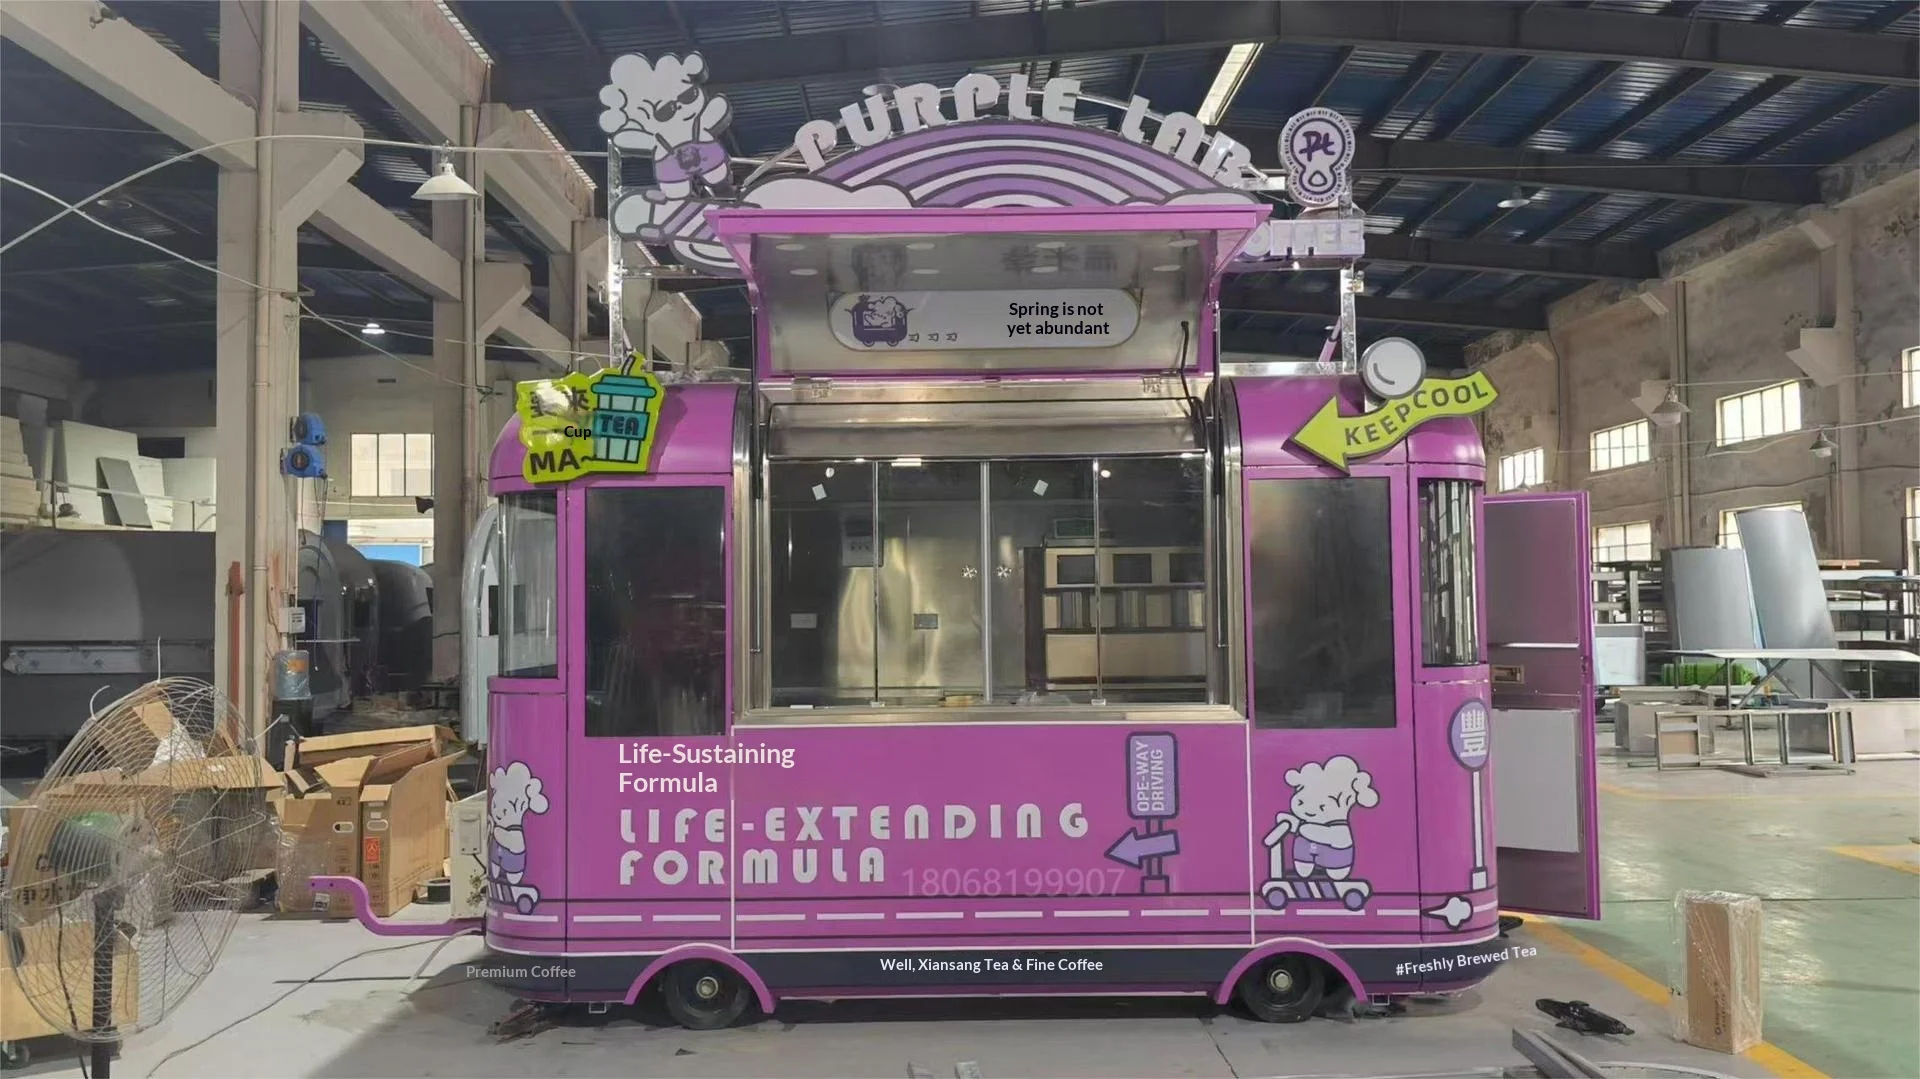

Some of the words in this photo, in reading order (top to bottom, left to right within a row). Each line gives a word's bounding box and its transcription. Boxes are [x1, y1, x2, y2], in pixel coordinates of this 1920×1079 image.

[795, 73, 1082, 173] PURPLE
[1121, 94, 1252, 188] LAB
[599, 414, 640, 436] TEA
[1135, 740, 1150, 812] OPE-WAY
[1150, 748, 1165, 812] DRIVING
[620, 846, 886, 885] FORMULA
